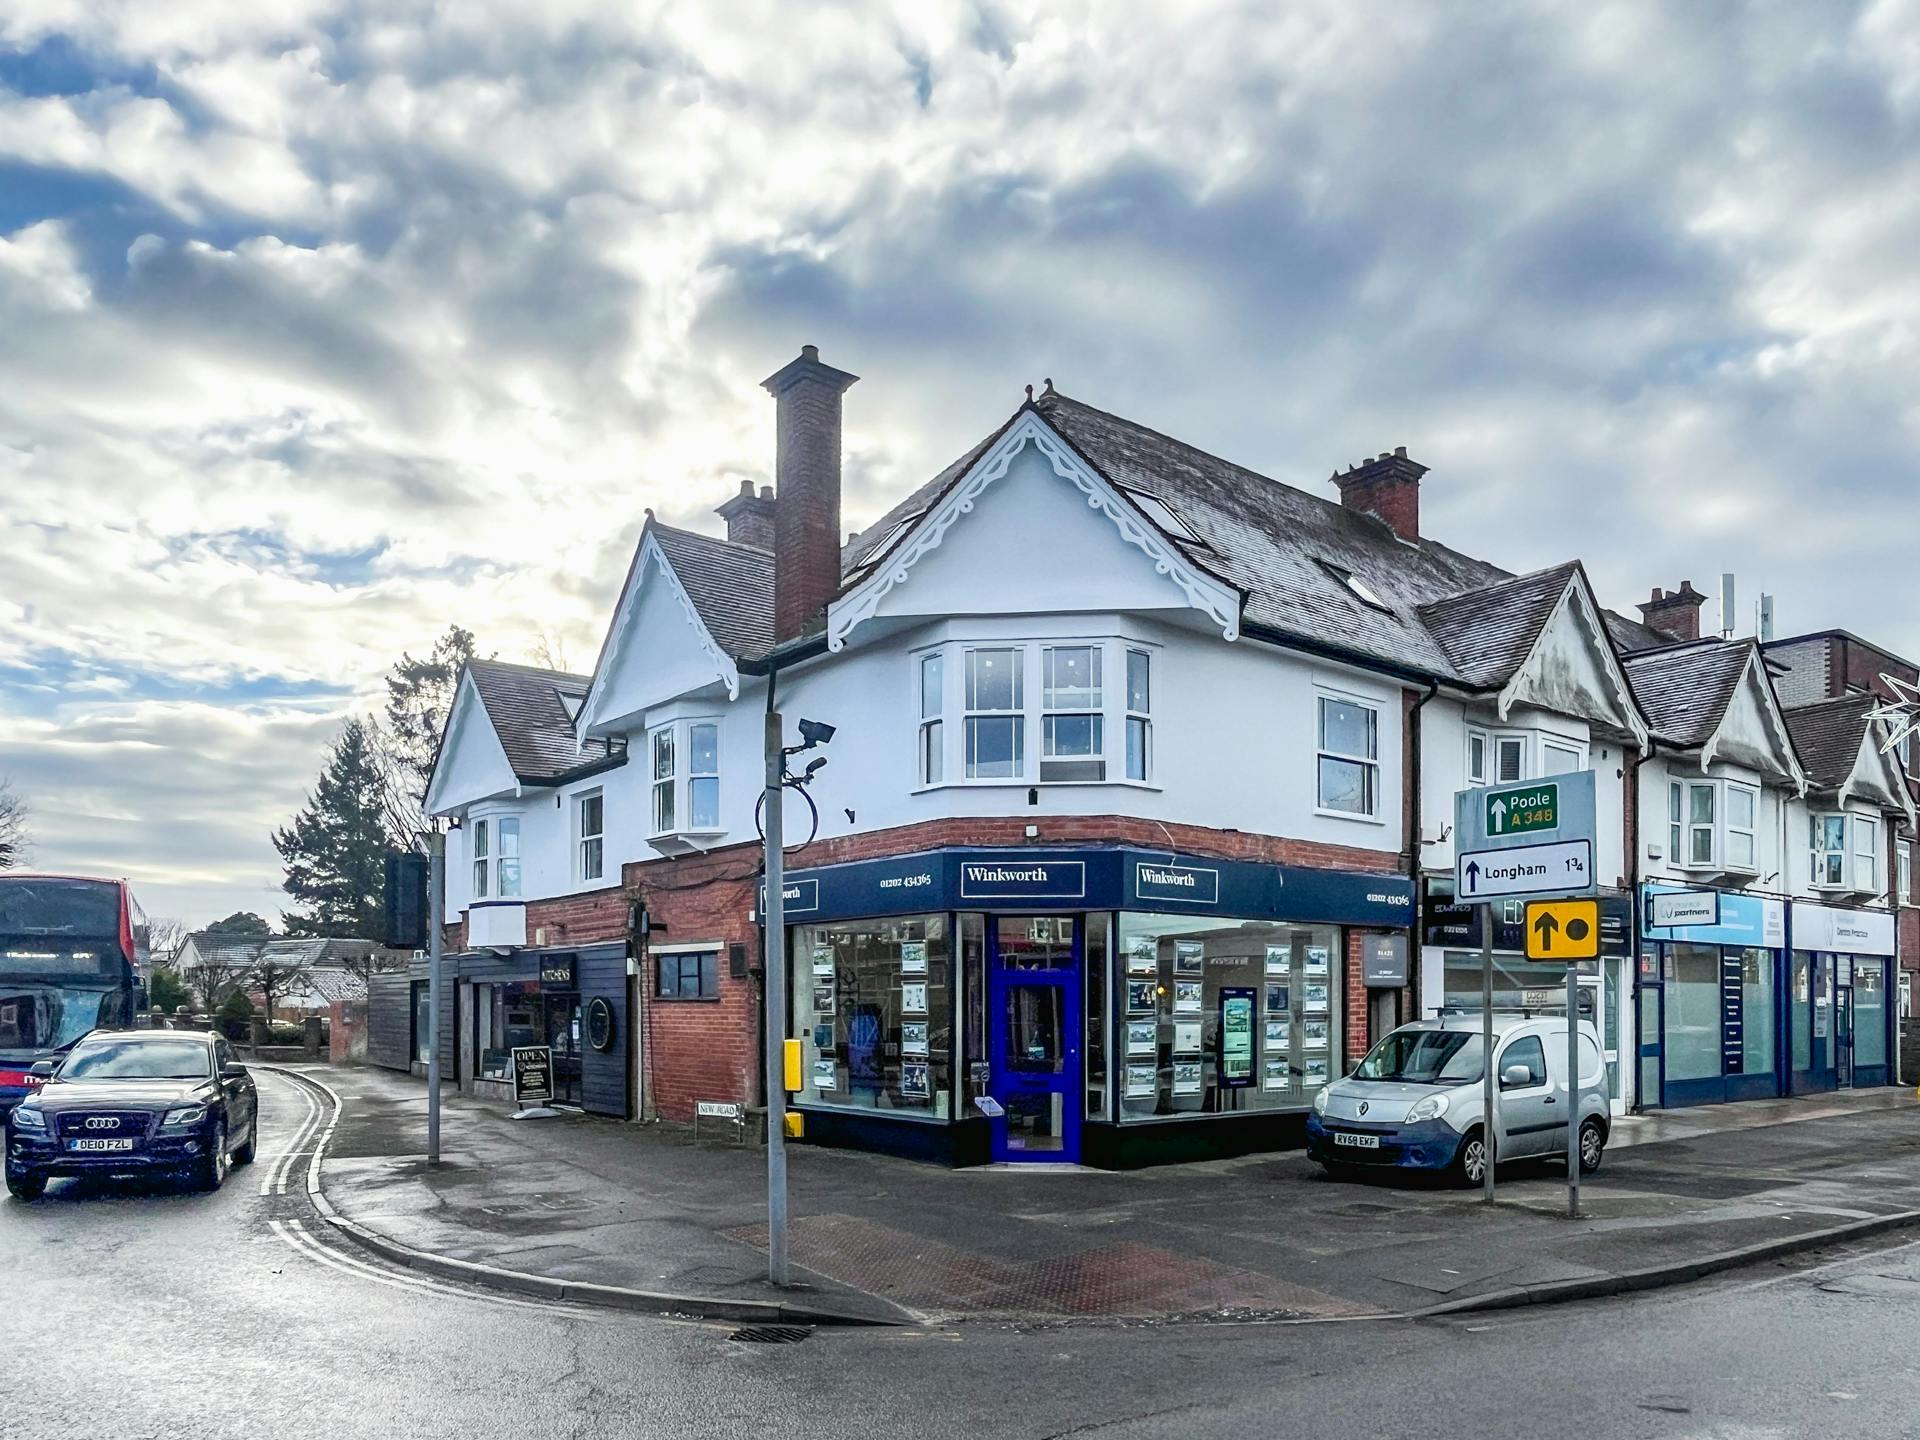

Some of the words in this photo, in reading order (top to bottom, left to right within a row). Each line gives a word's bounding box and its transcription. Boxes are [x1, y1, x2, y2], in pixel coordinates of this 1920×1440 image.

[1511, 793, 1550, 809] Poole
[1512, 813, 1521, 826] A
[1525, 809, 1553, 824] 348
[967, 867, 1048, 882] Winkworth
[1141, 868, 1195, 887] Winkworth
[1485, 864, 1547, 880] Longham
[880, 879, 902, 888] 01202
[903, 873, 931, 887] 434365
[1674, 909, 1710, 918] partners
[516, 1050, 547, 1061] OPEN
[700, 1104, 715, 1113] NEW
[717, 1105, 735, 1115] ROAD
[107, 1139, 129, 1149] FZL
